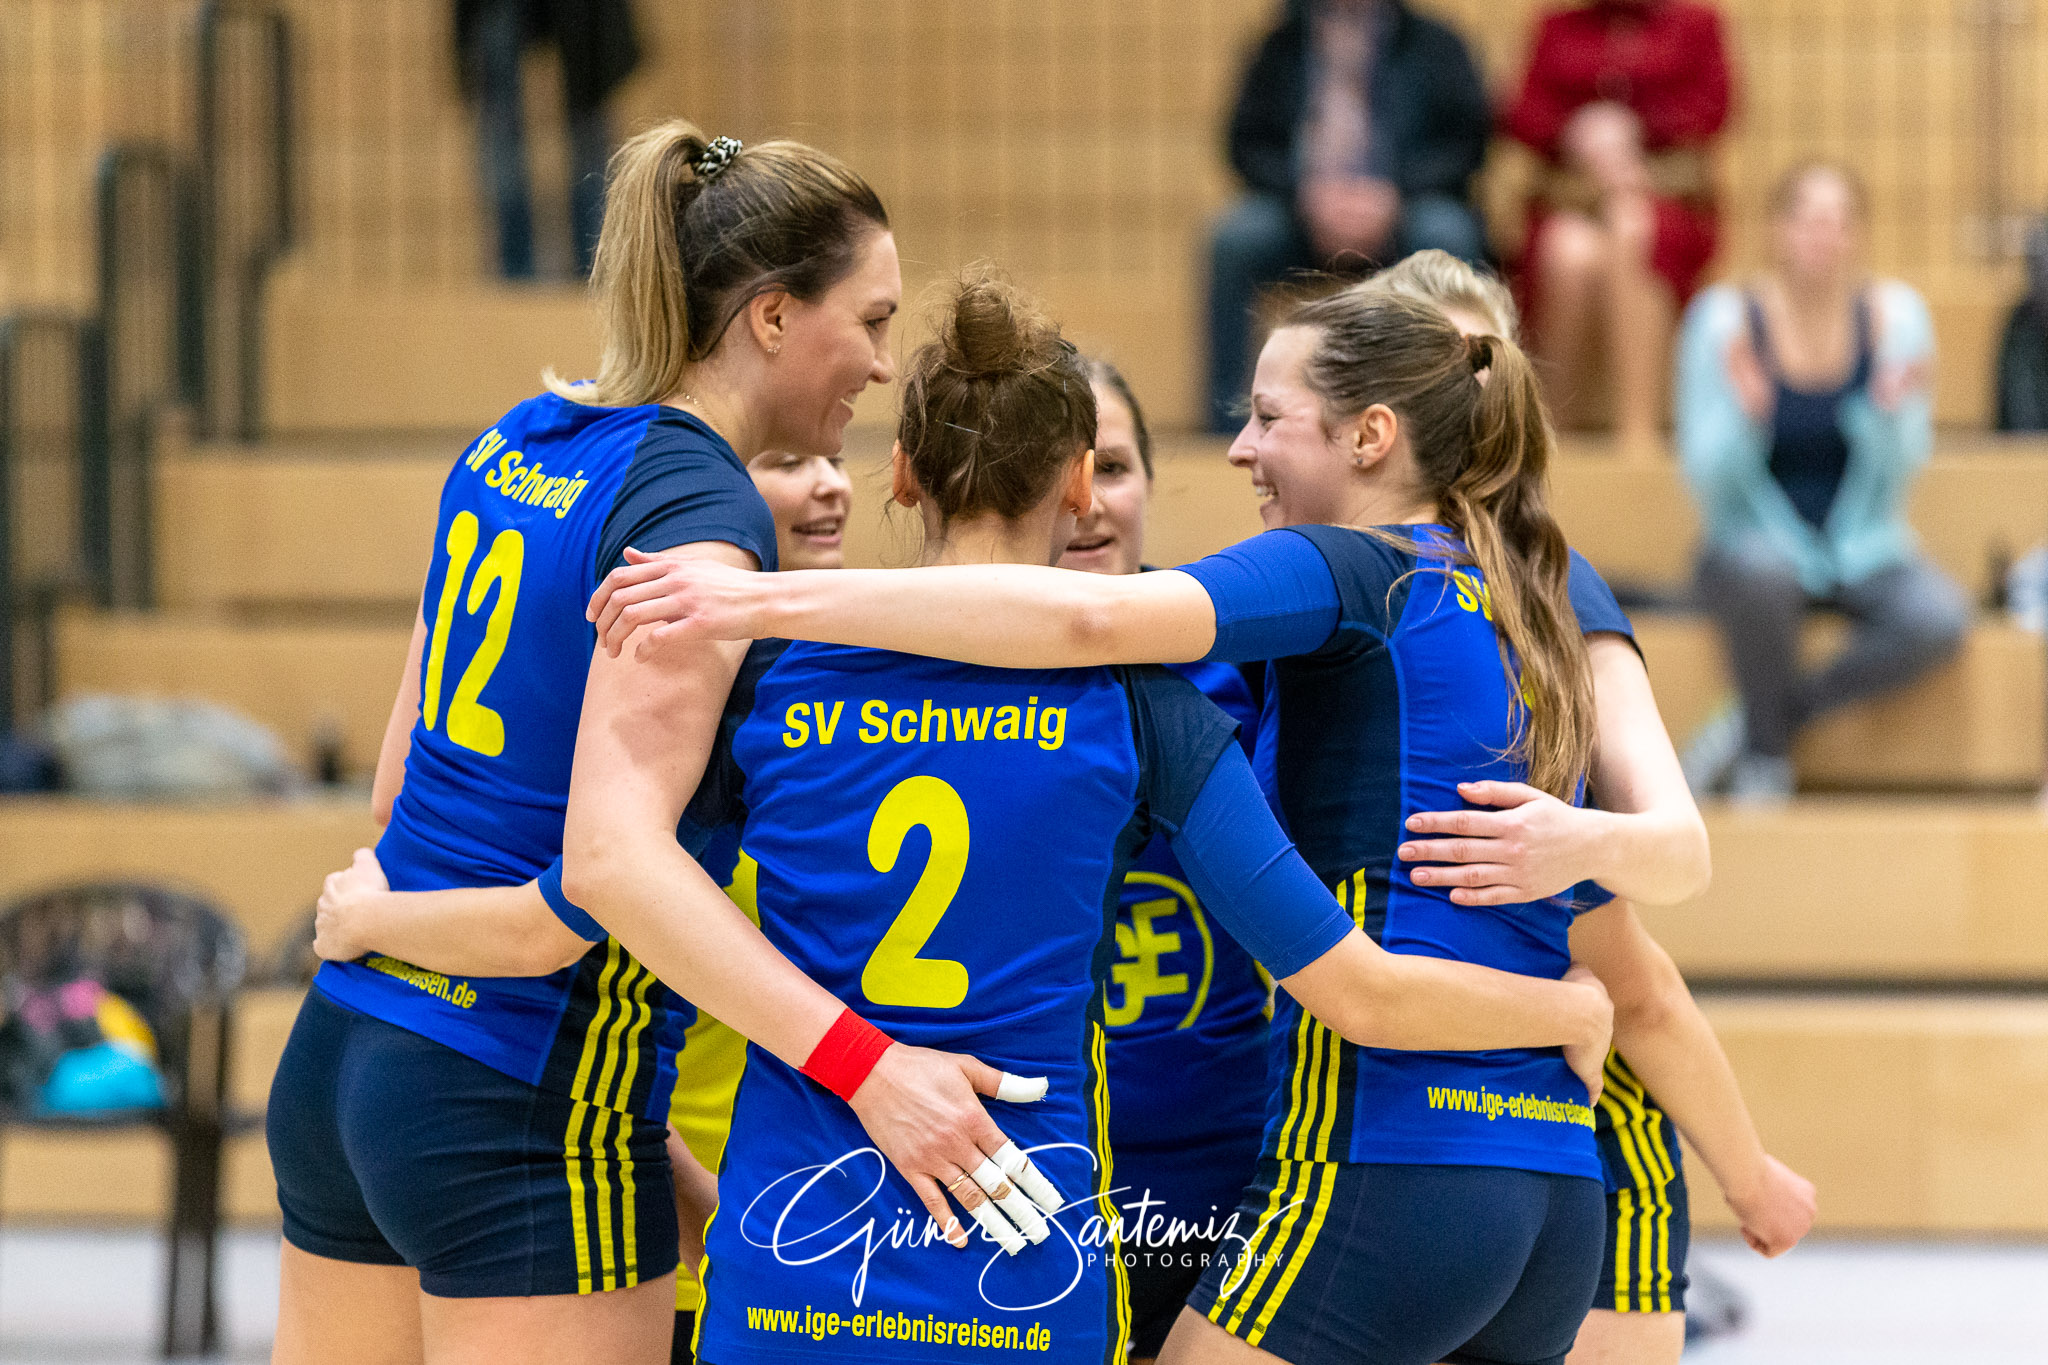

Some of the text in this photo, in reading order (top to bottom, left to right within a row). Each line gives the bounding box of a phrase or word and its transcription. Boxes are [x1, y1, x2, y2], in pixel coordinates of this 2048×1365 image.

[465, 428, 589, 519] SV Schwaig
[1453, 570, 1493, 622] SV
[423, 510, 524, 757] 12
[783, 696, 1067, 751] SV Schwaig
[861, 775, 970, 1009] 2
[747, 1307, 1051, 1352] www.ige-erlebnisreisen.de
